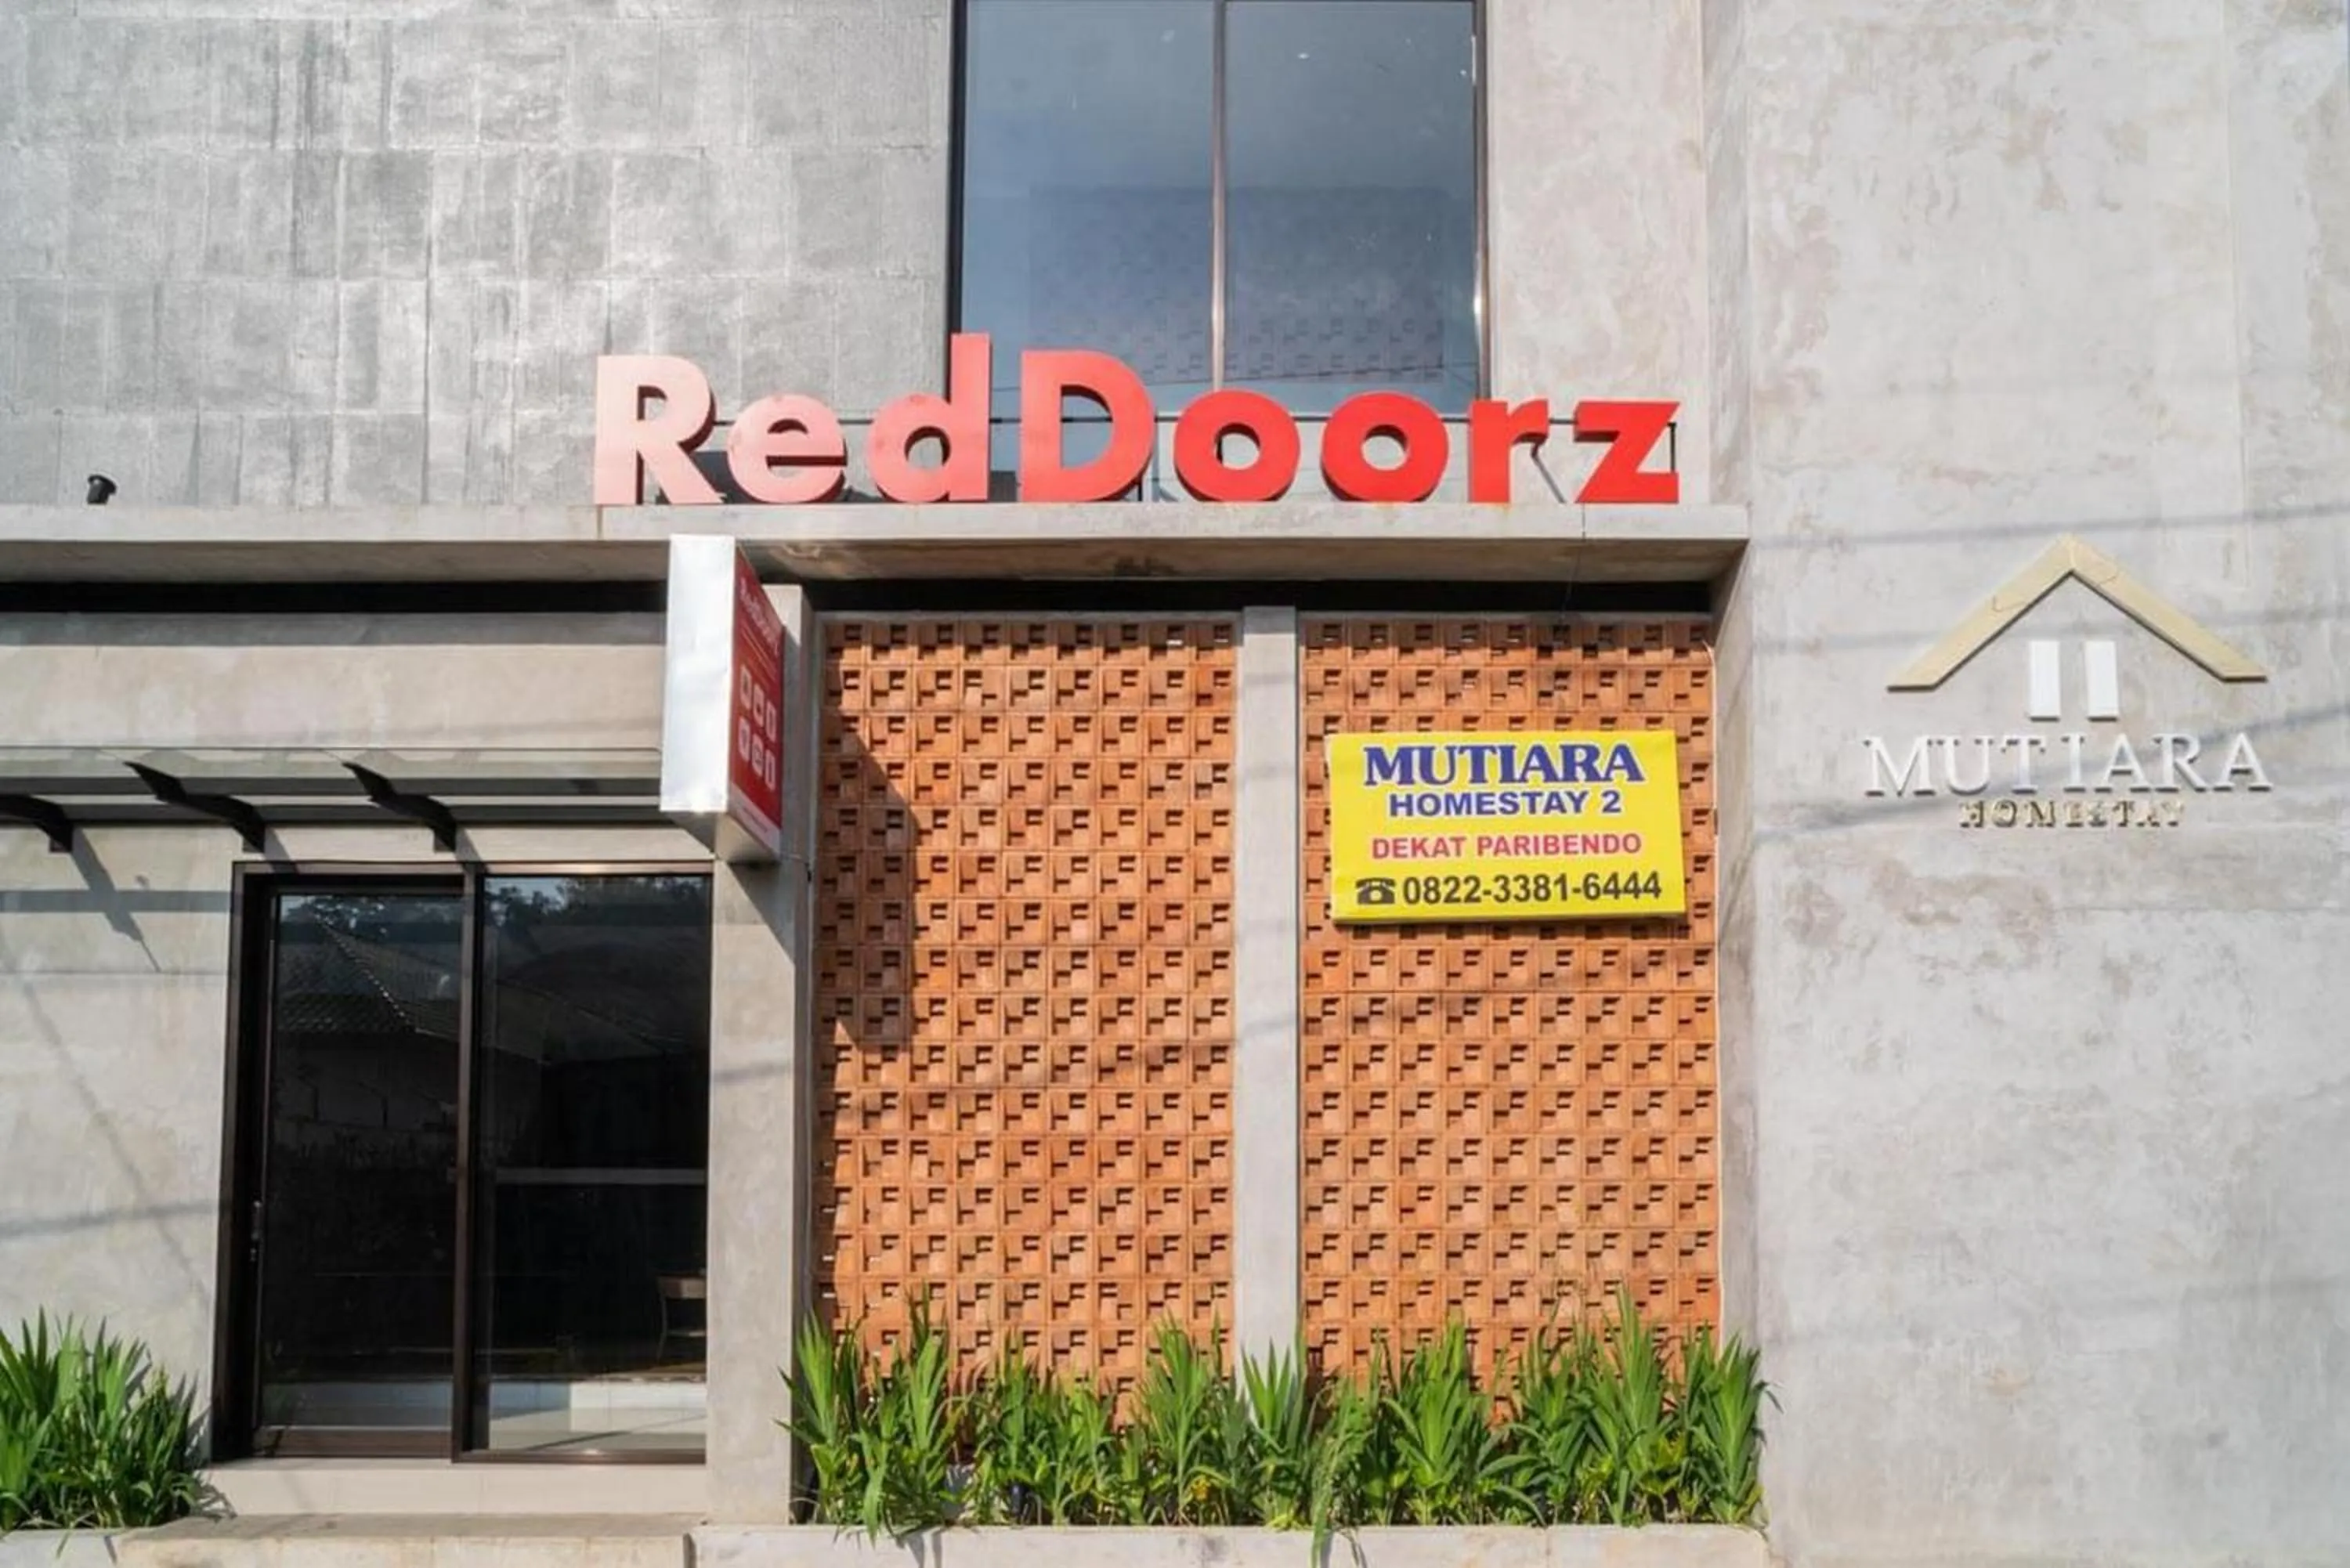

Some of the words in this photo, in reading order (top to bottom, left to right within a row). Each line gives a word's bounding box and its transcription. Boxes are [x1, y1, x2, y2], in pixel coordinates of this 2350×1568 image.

[594, 332, 1680, 504] RedDoorz
[1363, 743, 1646, 786] MUTIARA
[1862, 732, 2273, 796] MUTIARA
[1390, 791, 1589, 817] HOMESTAY
[1601, 789, 1622, 813] 2
[1372, 836, 1467, 859] DEKAT
[1477, 833, 1642, 857] PARIBENDO
[1402, 871, 1662, 905] 0822-3381-6444
